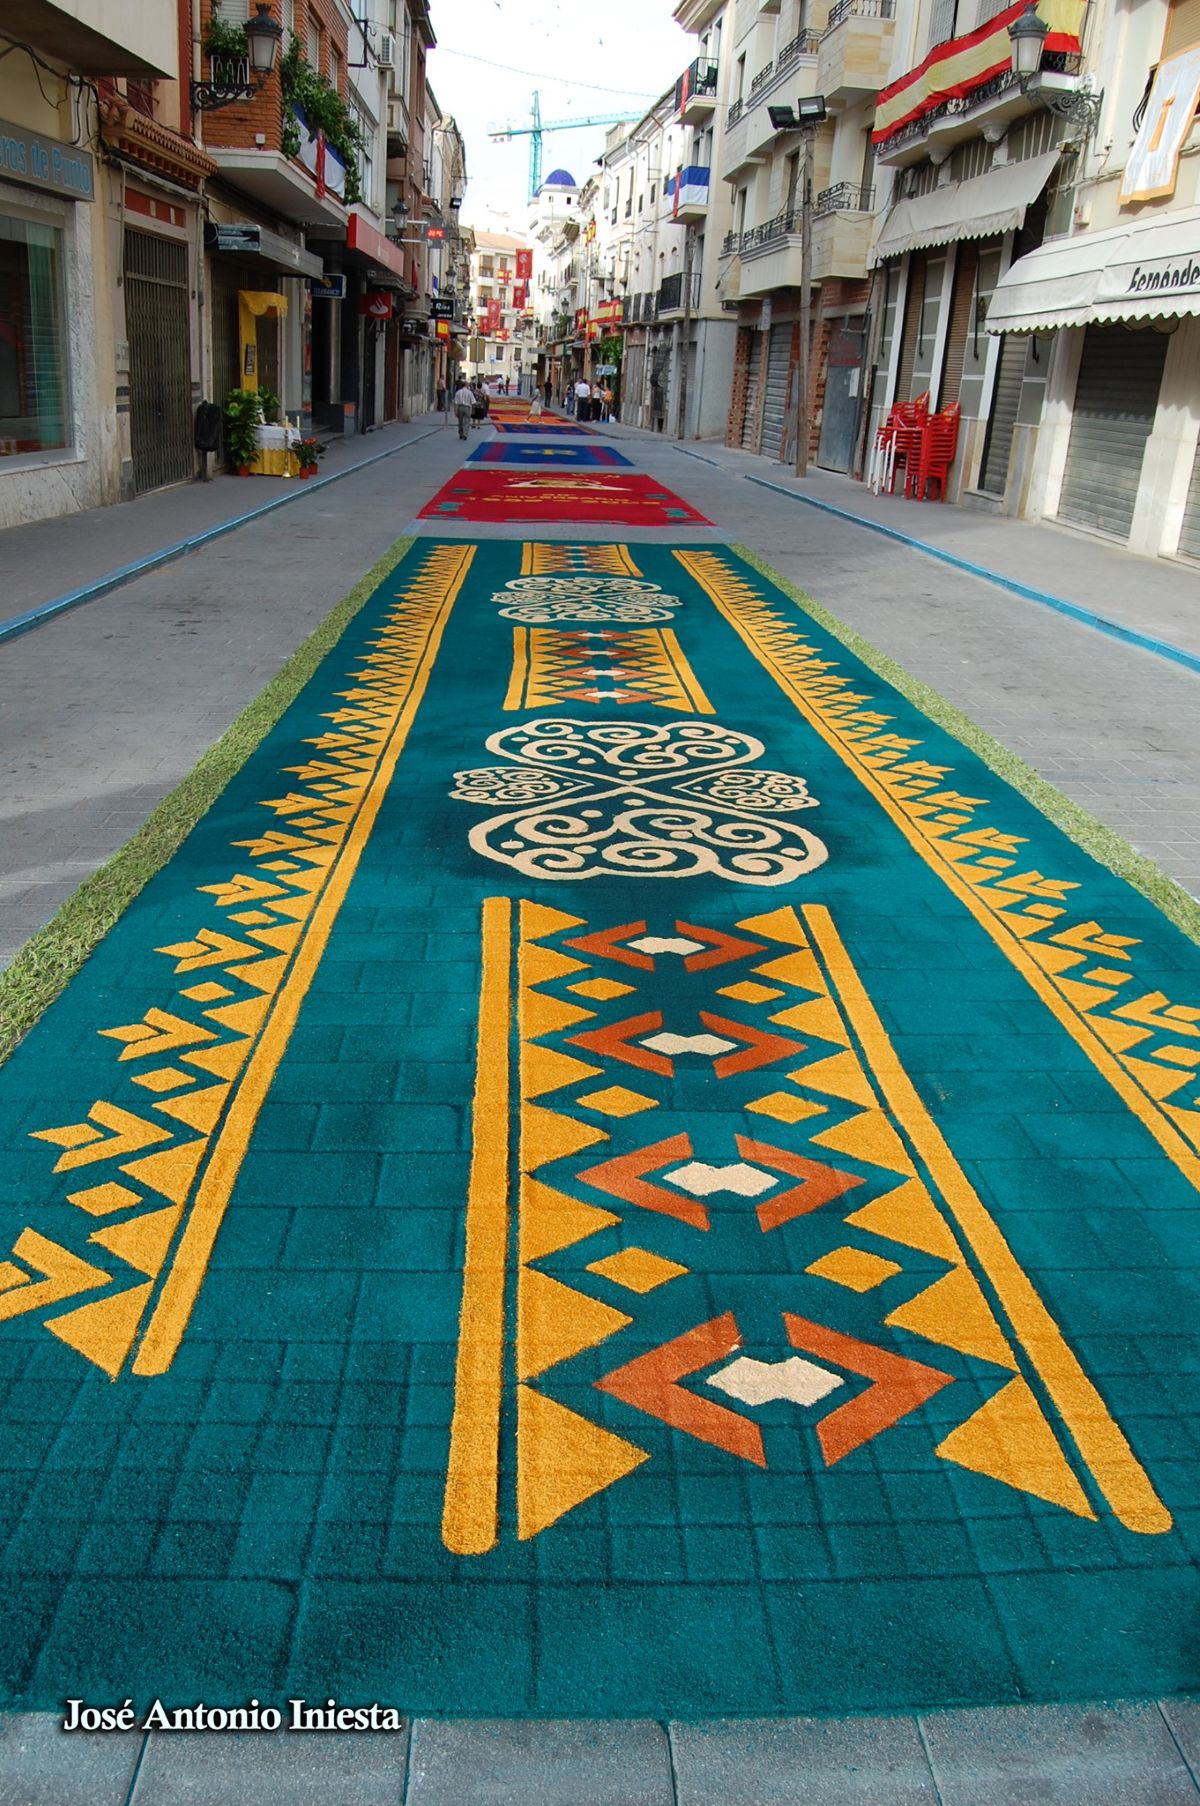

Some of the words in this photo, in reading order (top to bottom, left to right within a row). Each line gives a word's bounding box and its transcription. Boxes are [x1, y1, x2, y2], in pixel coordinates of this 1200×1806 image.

[31, 140, 49, 181] de
[51, 146, 91, 194] Punto
[1125, 259, 1200, 293] Fernánde
